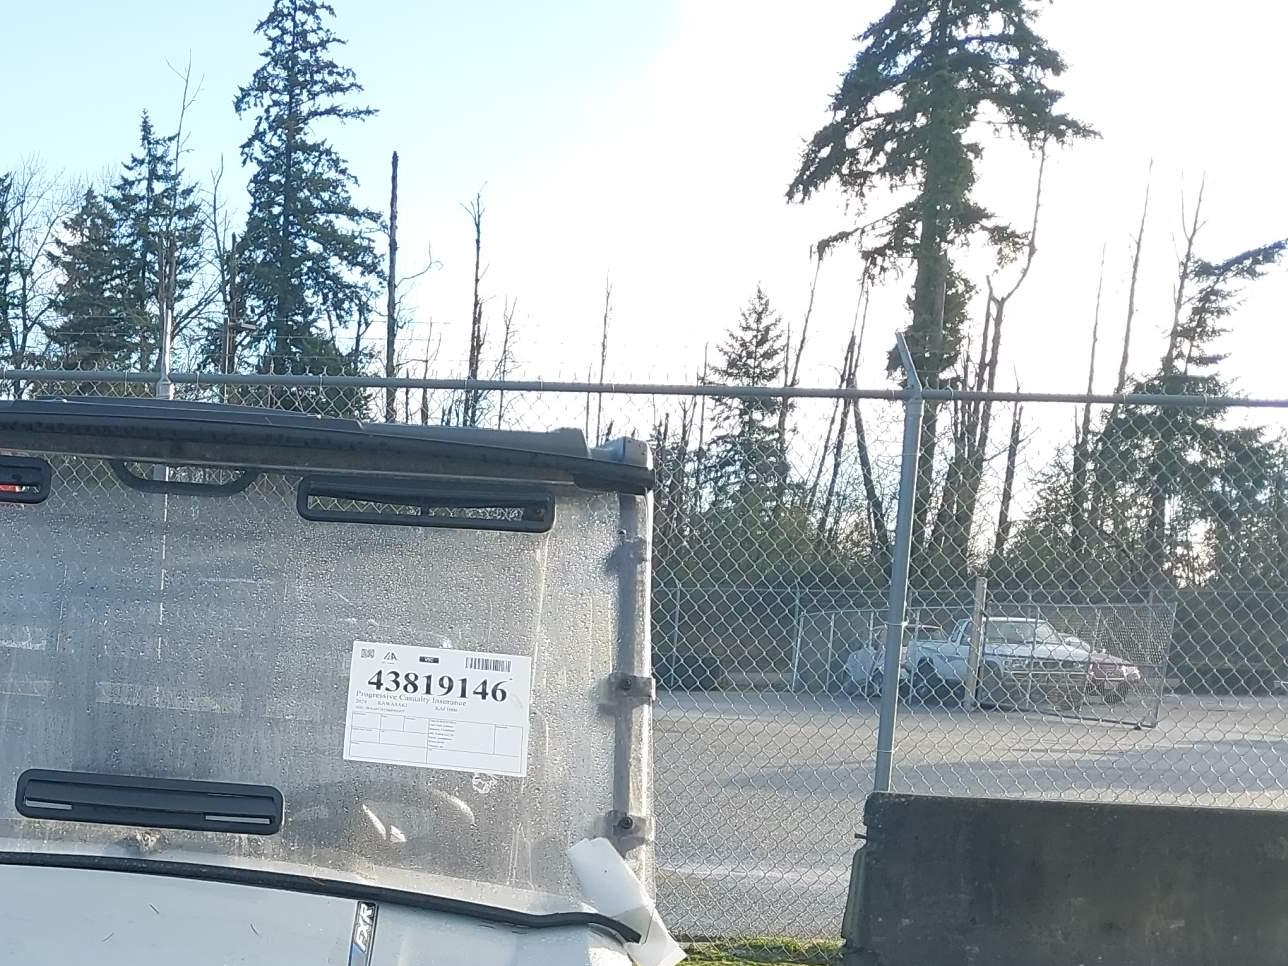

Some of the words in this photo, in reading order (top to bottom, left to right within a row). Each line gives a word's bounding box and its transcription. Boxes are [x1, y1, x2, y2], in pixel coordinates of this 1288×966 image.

[356, 689, 398, 701] Progressive
[399, 693, 430, 705] Casualty
[432, 697, 467, 707] Insurance
[367, 669, 509, 702] 43819146
[356, 903, 373, 952] FXR
